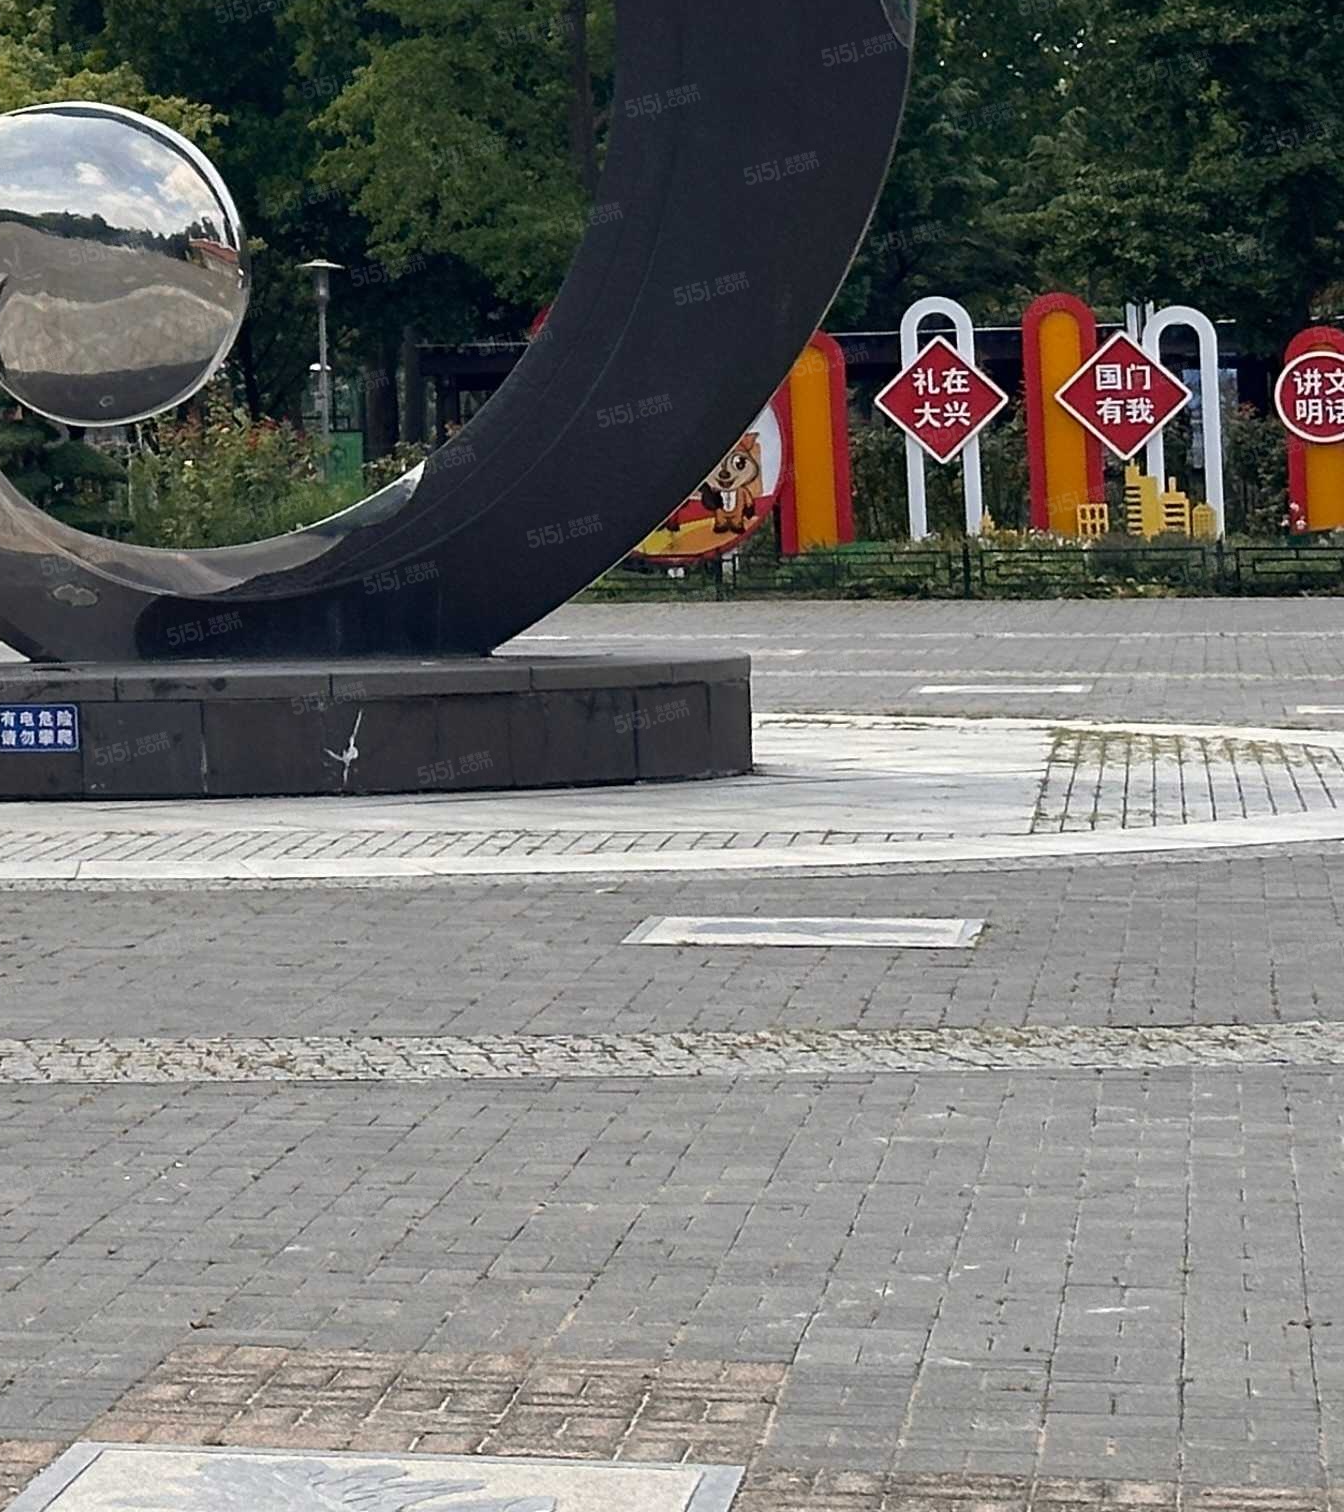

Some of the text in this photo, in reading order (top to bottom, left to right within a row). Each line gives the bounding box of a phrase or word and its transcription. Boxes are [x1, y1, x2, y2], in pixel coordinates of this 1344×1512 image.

[912, 368, 970, 395] 礼在
[1095, 364, 1150, 390] 国门
[913, 401, 971, 428] 大兴
[1095, 397, 1154, 424] 有我
[0, 710, 72, 727] 有电危险
[1, 730, 72, 746] 请勿攀爬
